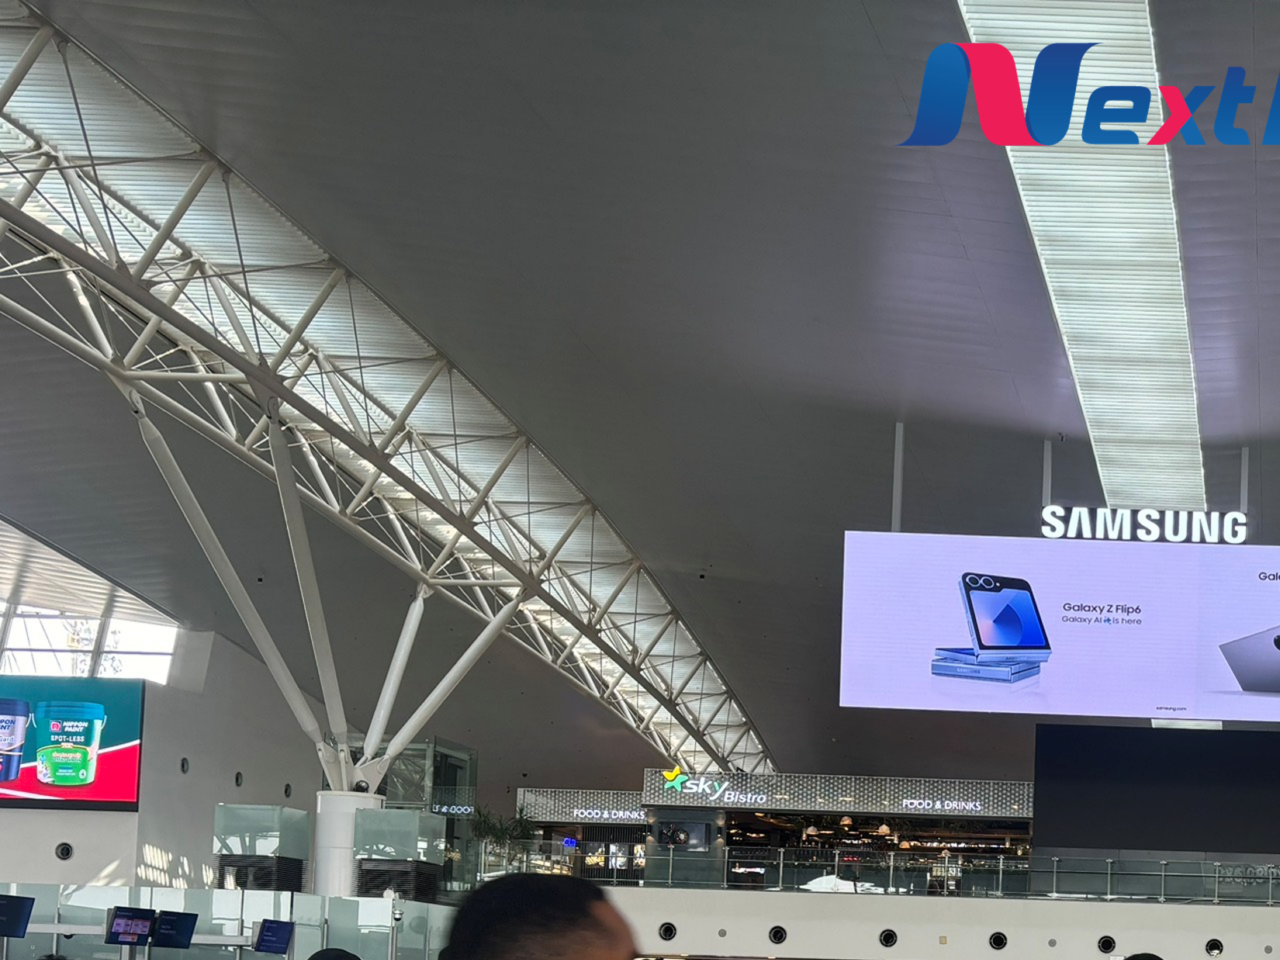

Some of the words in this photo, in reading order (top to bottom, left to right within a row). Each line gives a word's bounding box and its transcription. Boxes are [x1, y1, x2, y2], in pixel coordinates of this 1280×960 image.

[1041, 504, 1248, 544] SAMSUNG
[1062, 602, 1105, 615] Galaxy
[1106, 604, 1113, 613] Z
[1115, 604, 1142, 616] Flip6
[1061, 615, 1092, 625] Galaxy
[1121, 617, 1142, 625] here
[683, 777, 729, 800] sky
[724, 791, 767, 803] Bistro
[902, 799, 933, 809] FOOD
[934, 800, 942, 809] &
[944, 800, 981, 811] DRINKS
[573, 809, 600, 818] FOOD
[602, 810, 609, 818] &
[611, 810, 645, 820] DRINKS
